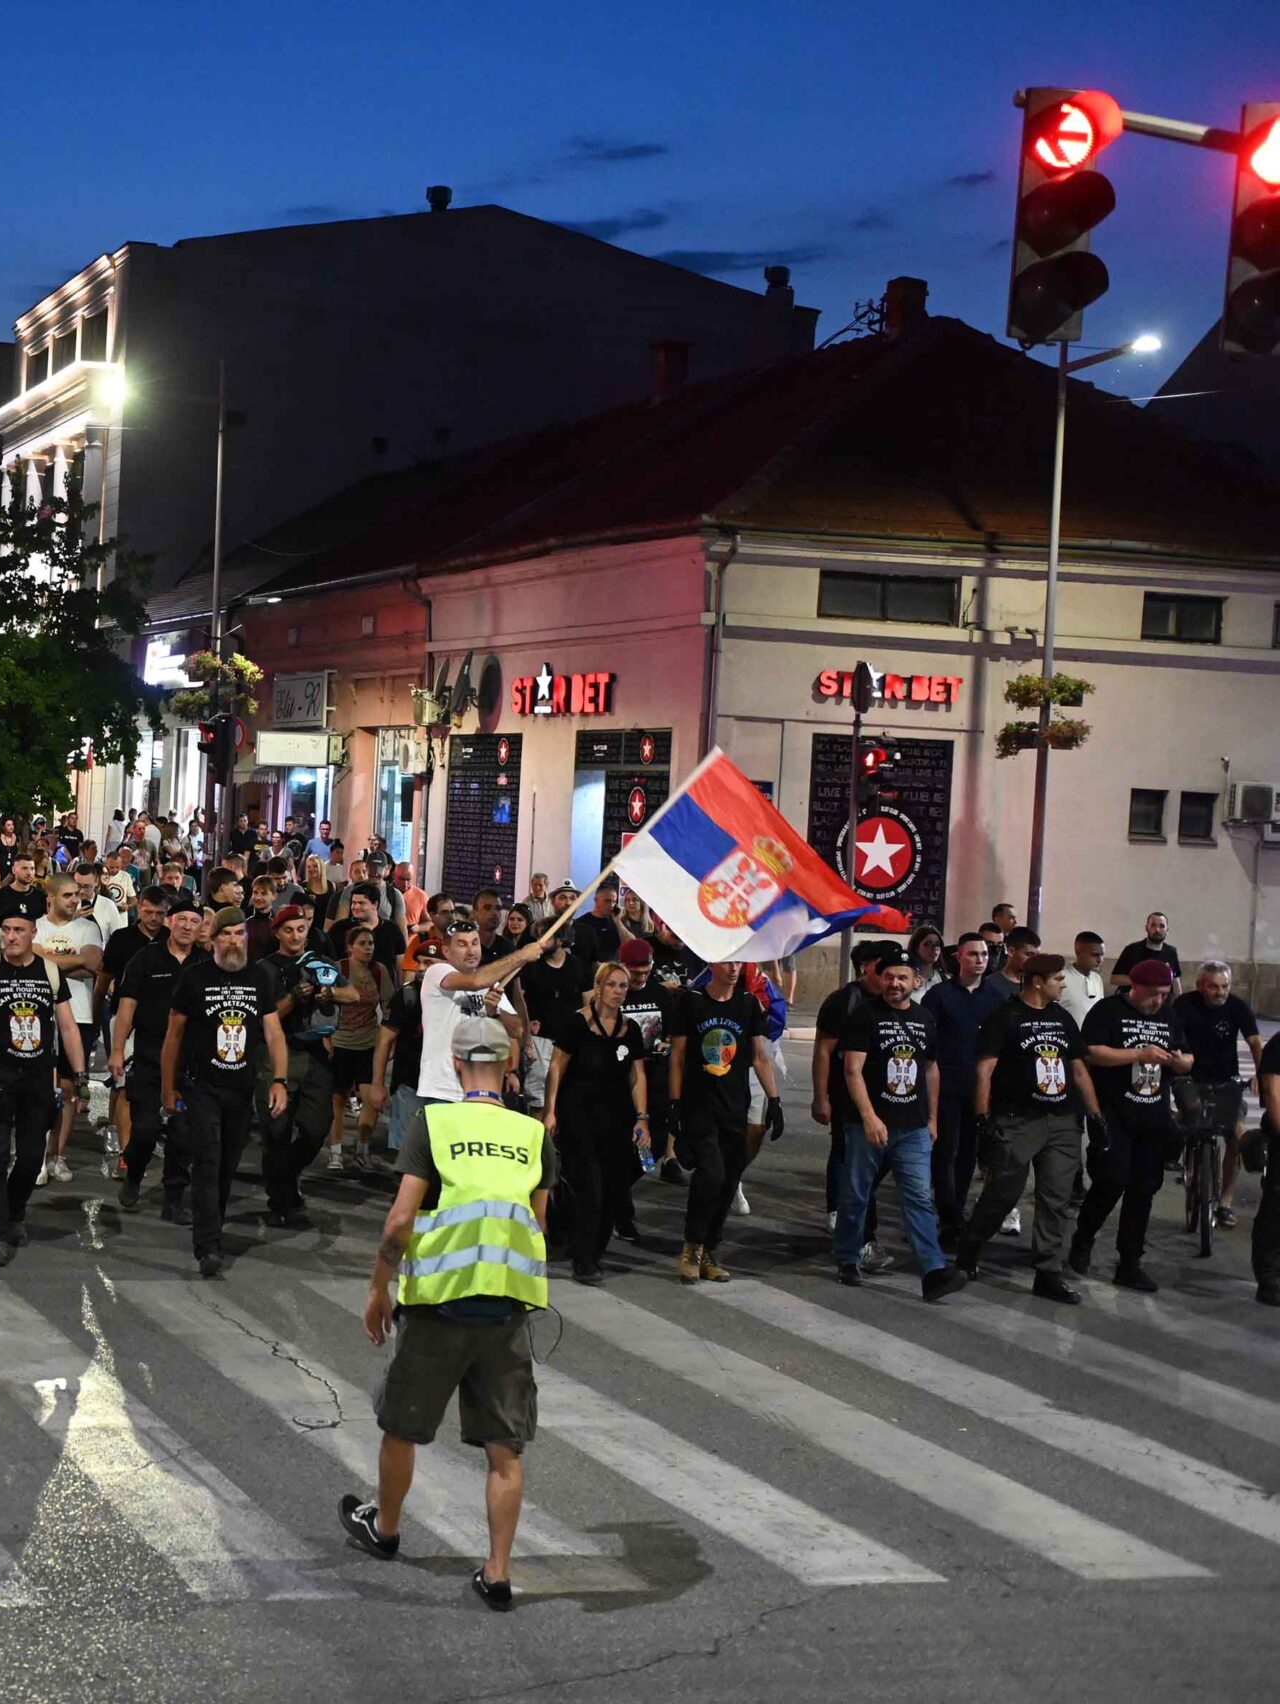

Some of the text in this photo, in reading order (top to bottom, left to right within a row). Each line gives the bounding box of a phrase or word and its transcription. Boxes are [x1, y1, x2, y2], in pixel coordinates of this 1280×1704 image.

[820, 663, 963, 703] STR BET
[571, 673, 610, 713] BET
[205, 1000, 258, 1016] ДАН ВЕТЕРАНА
[880, 1035, 926, 1050] ДАН ВЕТЕНА
[1020, 1034, 1068, 1049] ДАН ВЕТЕРАНА
[1123, 1034, 1168, 1048] ДАН ВЕТЕРАН
[450, 1141, 528, 1165] PRESS
